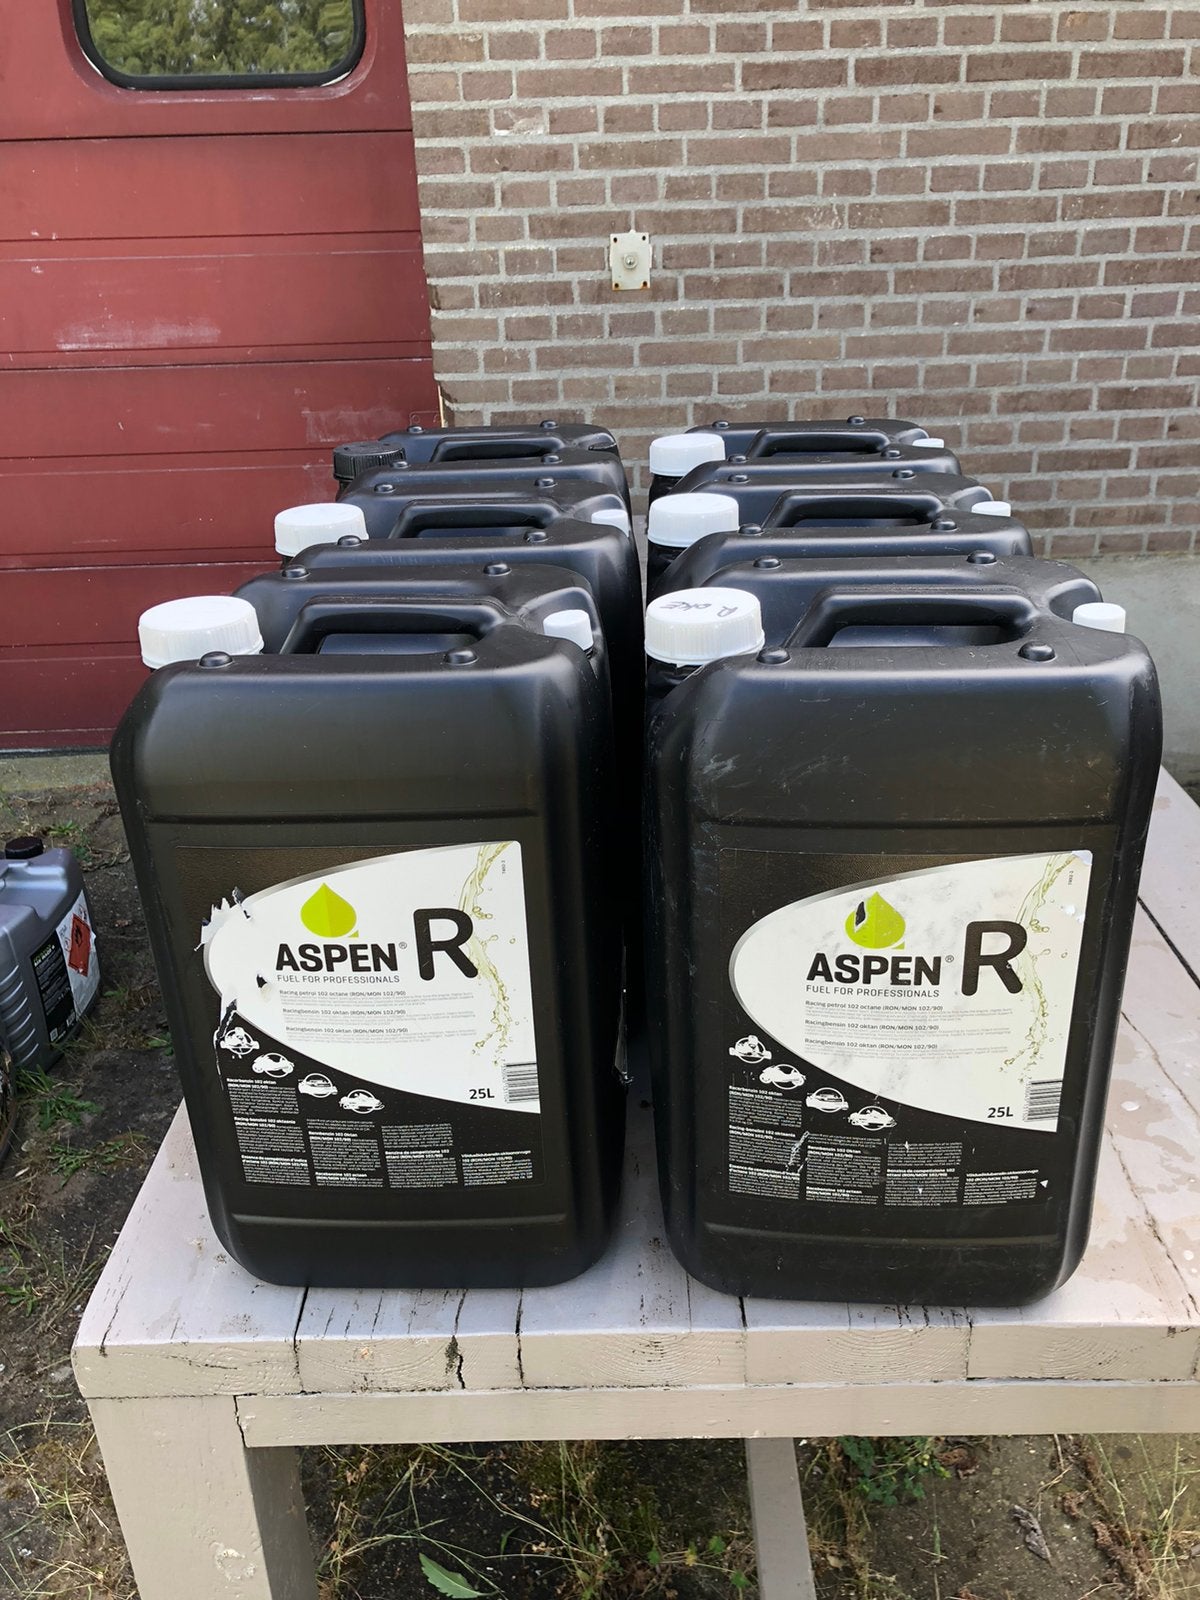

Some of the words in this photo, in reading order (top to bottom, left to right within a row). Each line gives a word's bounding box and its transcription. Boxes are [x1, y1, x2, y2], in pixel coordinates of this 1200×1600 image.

[414, 908, 477, 980] R
[961, 920, 1027, 996] R
[277, 974, 300, 983] FUEL
[323, 975, 400, 983] PROFESSIONALS
[806, 985, 830, 994] FUEL
[834, 986, 854, 995] FOR
[857, 988, 940, 997] PROFESSIONALS
[469, 1088, 495, 1100] 25L
[987, 1106, 1014, 1118] 25L
